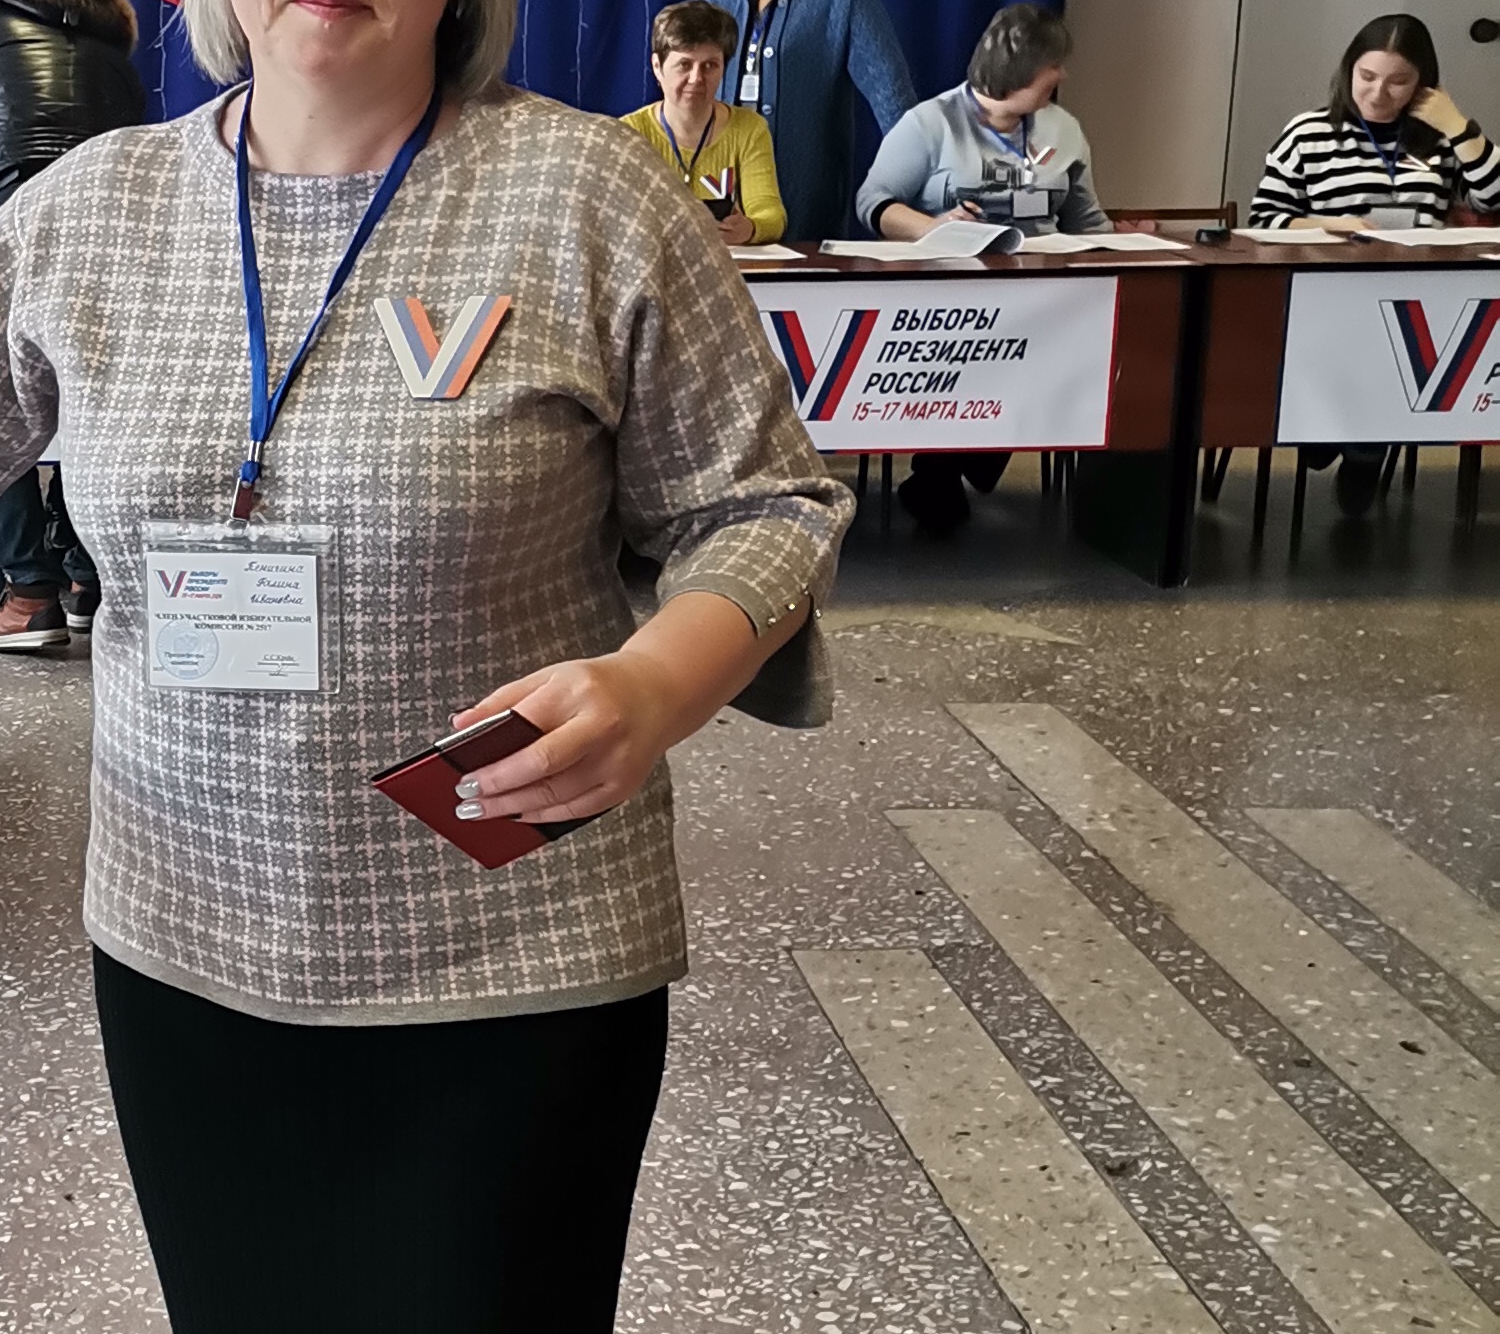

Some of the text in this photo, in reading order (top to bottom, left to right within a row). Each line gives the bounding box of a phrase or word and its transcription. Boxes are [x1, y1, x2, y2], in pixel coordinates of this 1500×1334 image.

[890, 307, 1001, 332] ВЫБОРЫ
[876, 337, 1029, 366] ПРЕЗИДЕНТА
[861, 370, 962, 395] РОССИИ
[899, 400, 958, 422] МАРТА
[959, 399, 1003, 421] 2024
